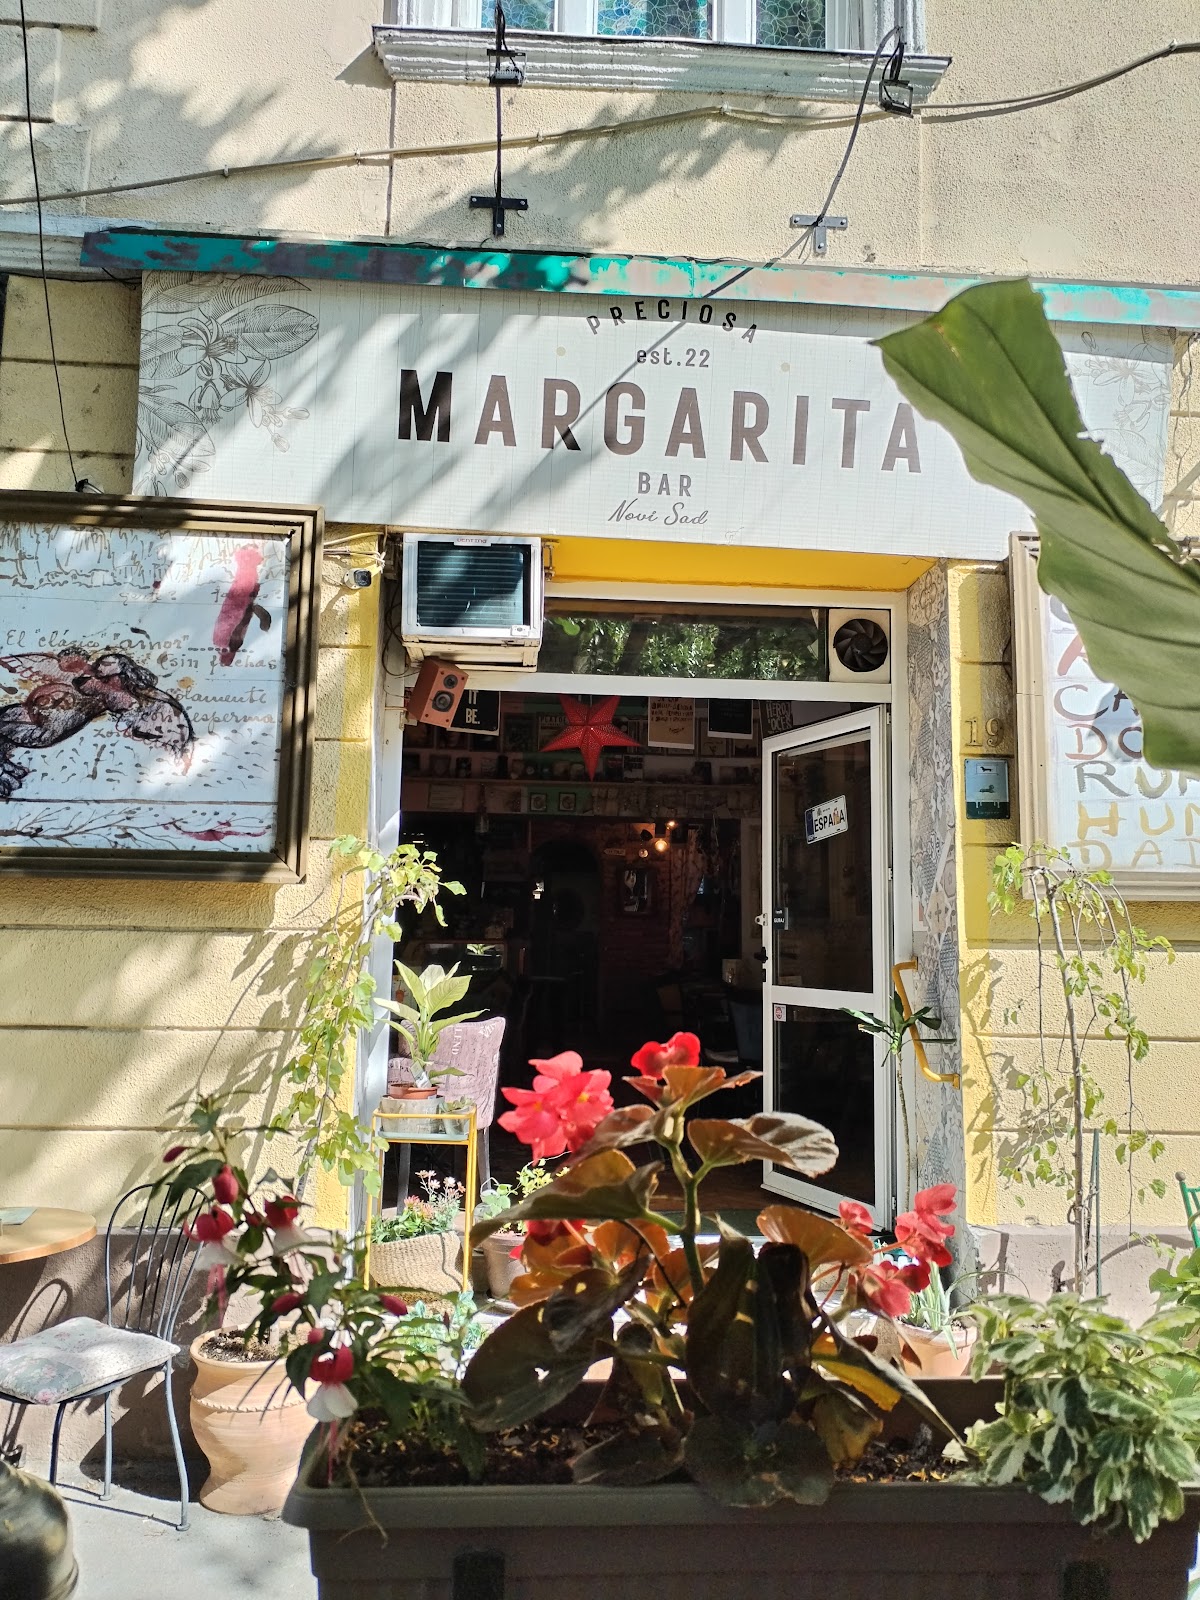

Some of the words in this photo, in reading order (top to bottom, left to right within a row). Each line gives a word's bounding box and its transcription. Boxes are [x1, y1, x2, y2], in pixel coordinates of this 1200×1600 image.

[586, 299, 757, 343] PRECIOSA
[636, 347, 711, 368] est.22
[398, 369, 921, 473] MARGARITA
[637, 471, 692, 497] BAR
[607, 497, 659, 522] Novi
[663, 501, 709, 526] Sad
[6, 629, 26, 647] El
[467, 689, 479, 705] IT
[465, 708, 481, 725] BE.
[964, 716, 1005, 748] 19
